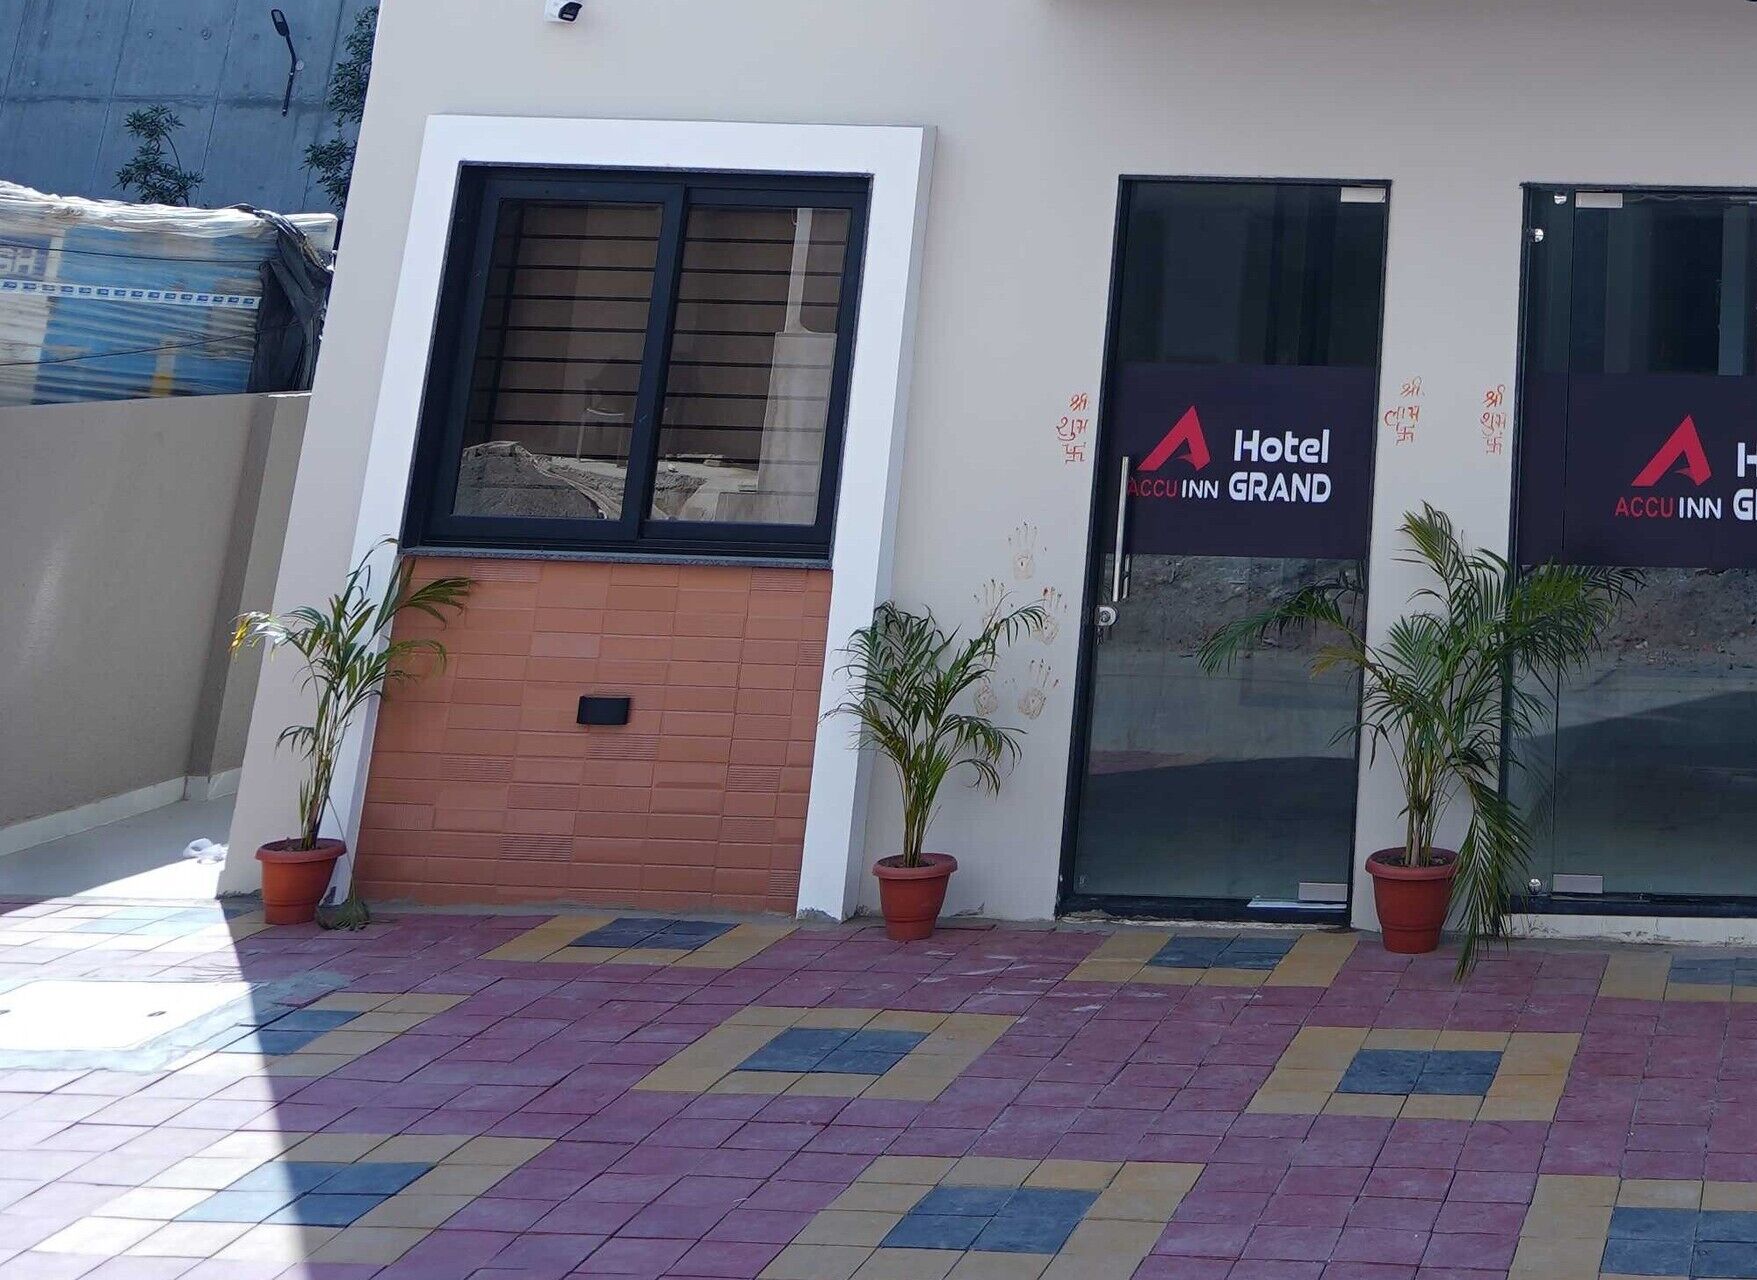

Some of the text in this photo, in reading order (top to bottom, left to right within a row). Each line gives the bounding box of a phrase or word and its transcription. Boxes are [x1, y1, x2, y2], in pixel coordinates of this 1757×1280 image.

[1233, 428, 1330, 464] Hotel
[1181, 479, 1219, 499] INN
[1228, 471, 1332, 503] GRAND
[1614, 495, 1722, 520] ACCU INN
